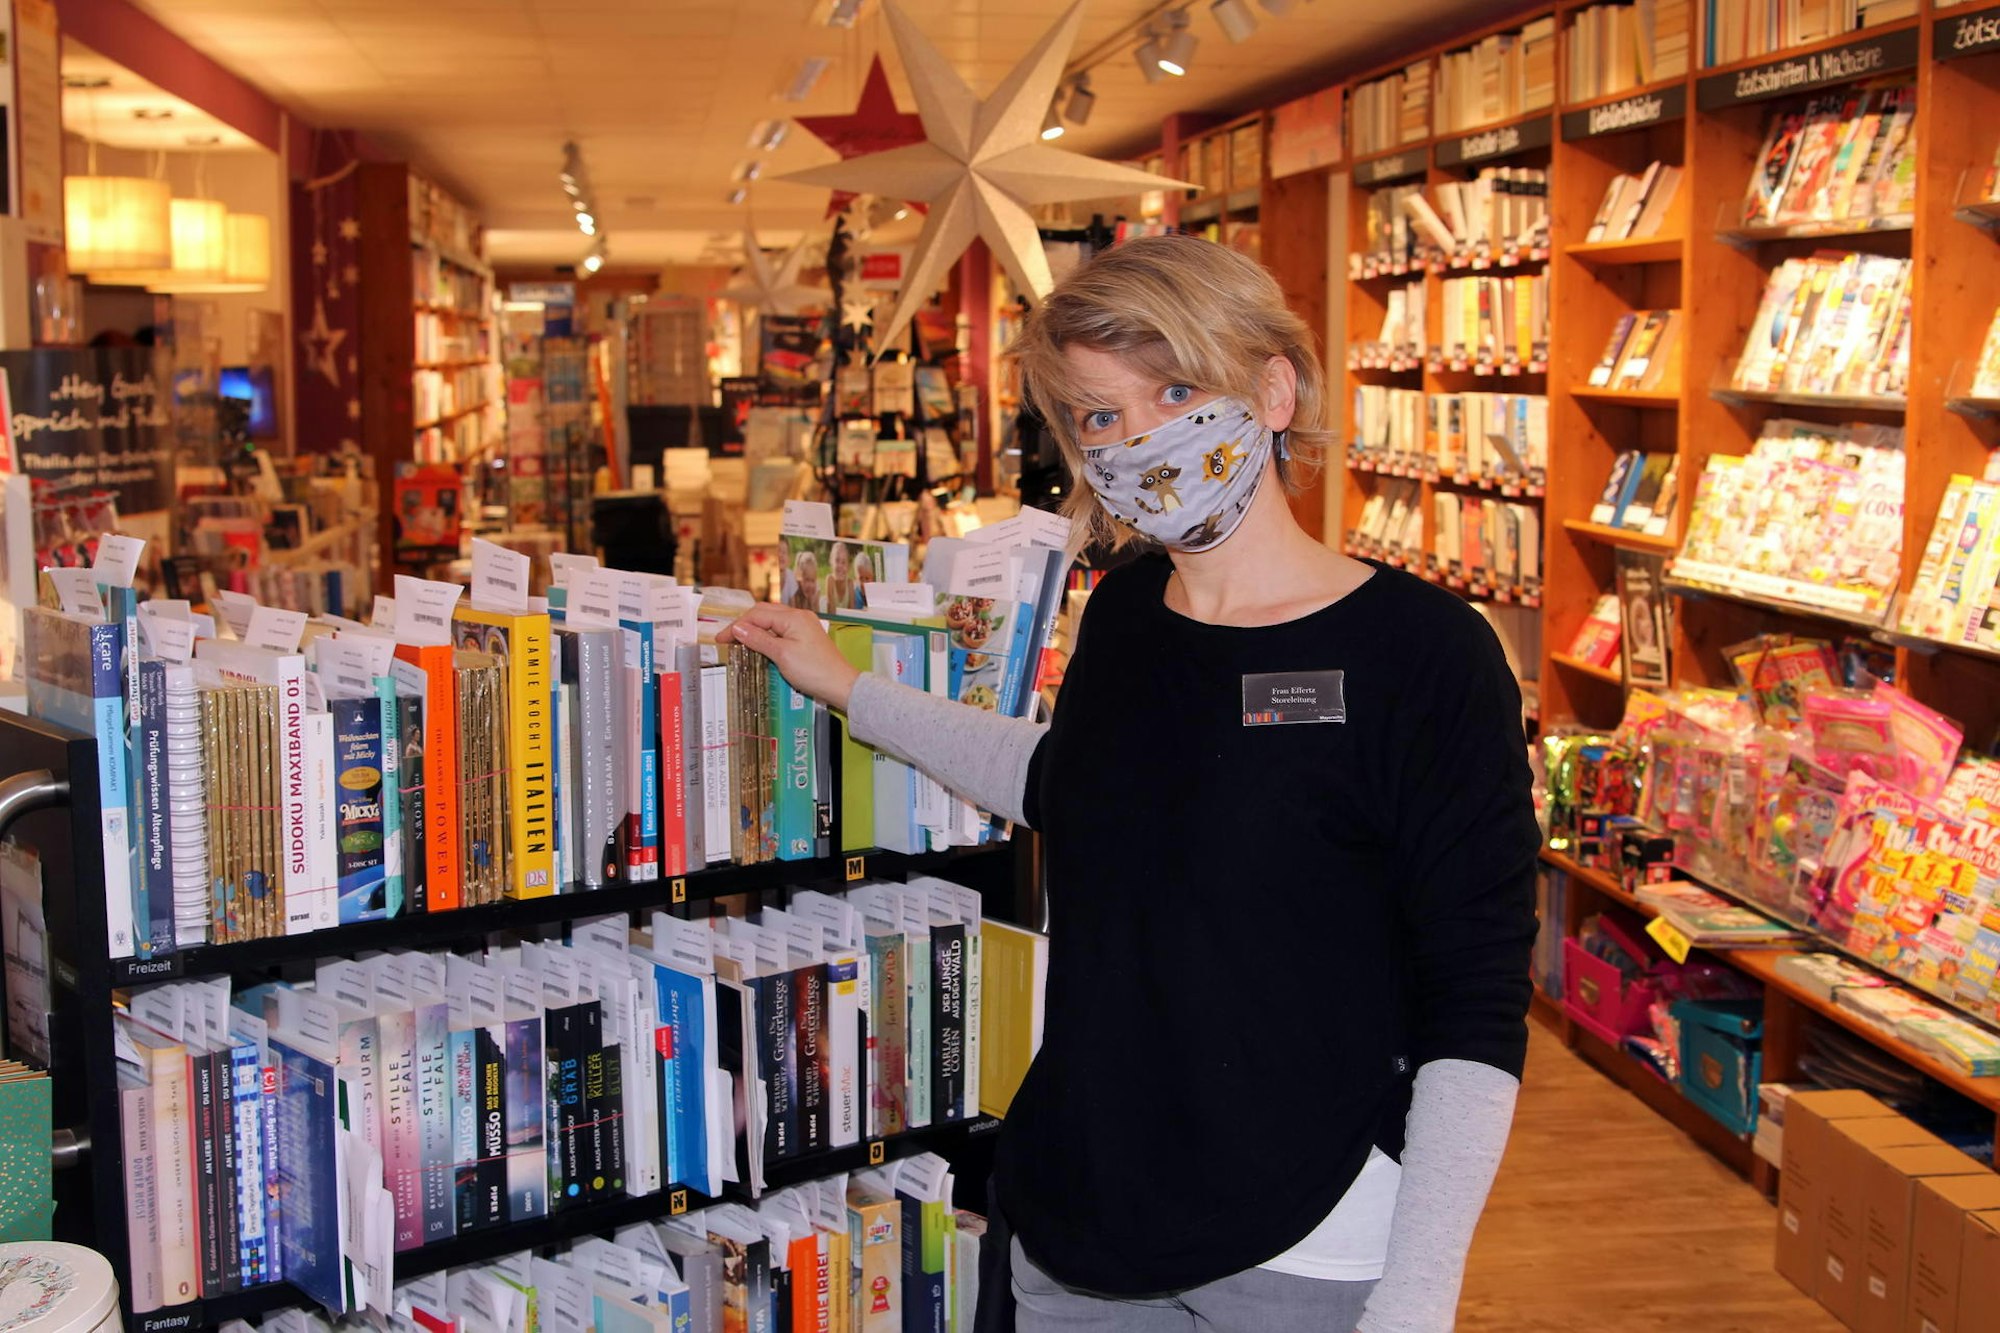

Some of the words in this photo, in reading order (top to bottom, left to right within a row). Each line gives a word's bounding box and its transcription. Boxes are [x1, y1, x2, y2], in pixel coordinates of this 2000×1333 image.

[1735, 61, 1808, 97] Zeitschriften
[1810, 56, 1820, 81] &
[528, 636, 539, 687] JAMIE
[602, 645, 611, 670] Land
[643, 640, 651, 684] Mathematik
[287, 676, 300, 698] 01
[1271, 695, 1317, 705] Storeleitung
[1272, 687, 1289, 695] Frau
[1291, 686, 1316, 694] Effertz
[528, 700, 541, 752] KOCHT
[673, 705, 681, 751] MAPLETON
[147, 730, 161, 811] Prüfungswissen
[289, 702, 303, 797] MAXIBAND
[793, 727, 809, 790] SKYJO
[605, 755, 614, 795] OBAMA
[414, 791, 423, 841] CROWN
[526, 762, 545, 854] ITALIEN
[606, 797, 615, 845] BARACK
[151, 812, 164, 870] Altenpflege
[291, 801, 304, 874] SUDOKU
[436, 801, 448, 877] POWER
[528, 872, 547, 886] DK
[848, 860, 862, 875] M
[128, 960, 171, 975] Freizeit
[886, 950, 896, 984] WILD
[942, 949, 952, 991] JUNGE
[951, 940, 962, 976] WALD
[942, 993, 951, 1012] DER
[952, 977, 960, 998] DEM
[952, 999, 960, 1018] AUS
[670, 989, 679, 1045] Schritte
[772, 979, 788, 1062] Götterkriege
[804, 975, 819, 1056] Götterkriege
[360, 1036, 373, 1101] STURM
[401, 1049, 412, 1093] FALL
[433, 1041, 444, 1085] FALL
[942, 1027, 952, 1077] HARLAN
[950, 1029, 961, 1073] COBEN
[201, 1068, 209, 1093] NICHT
[221, 1063, 229, 1087] NICHT
[222, 1088, 230, 1099] DU
[389, 1061, 401, 1125] STILLE
[421, 1054, 433, 1117] STILLE
[456, 1078, 464, 1098] WAS
[491, 1062, 499, 1095] BROOKLYN
[565, 1058, 578, 1105] GRAB
[591, 1052, 603, 1098] KILLER
[608, 1058, 620, 1096] BLUT
[202, 1093, 209, 1105] DU
[267, 1098, 276, 1117] Fox
[842, 1066, 851, 1132] steuer:Mac
[203, 1106, 211, 1138] STIRBST
[267, 1117, 277, 1145] Spirit
[461, 1105, 474, 1157] MUSSO
[488, 1111, 501, 1157] MUSSO
[778, 1121, 786, 1147] PIPER
[204, 1139, 212, 1160] LIEBE
[205, 1161, 212, 1175] AN
[226, 1156, 233, 1168] AN
[268, 1144, 277, 1170] Tales
[568, 1134, 577, 1177] KLAUS-PETER
[593, 1127, 602, 1170] KLAUS-PETER
[612, 1127, 620, 1169] KLAUS-PETER
[490, 1185, 498, 1213] PIPER
[817, 1252, 828, 1294] IRRE!
[145, 1314, 190, 1332] Fantasy
